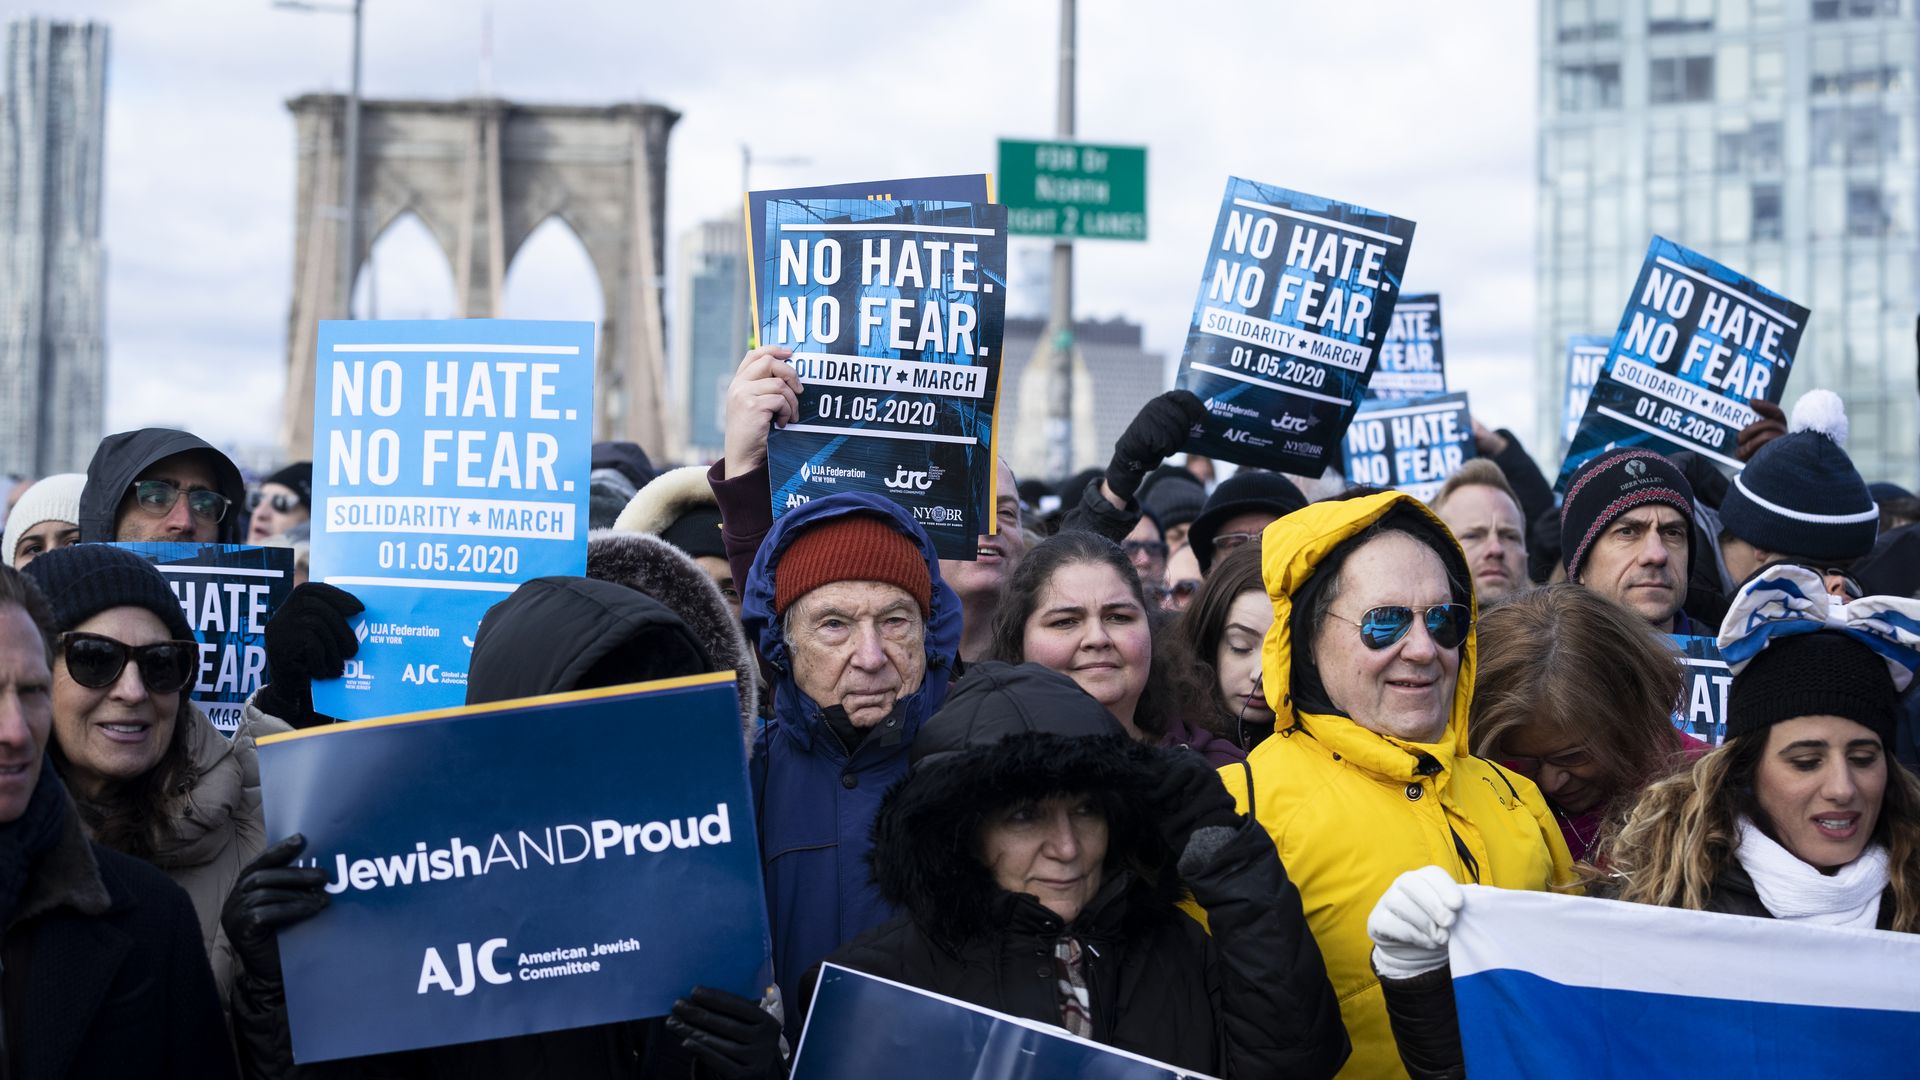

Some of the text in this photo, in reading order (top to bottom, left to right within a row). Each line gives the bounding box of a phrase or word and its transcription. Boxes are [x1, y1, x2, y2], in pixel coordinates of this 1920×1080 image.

[1008, 205, 1144, 236] IGHT 2 LANES
[779, 239, 993, 293] NO HATE.
[1222, 210, 1390, 292] NO HATE.
[1209, 258, 1376, 341] NO FEAR.
[777, 296, 988, 357] NO FEAR.
[1386, 312, 1440, 341] ATE.
[1641, 268, 1787, 368] NO HATE.
[1206, 313, 1363, 367] SOLIDARITY MARCH
[1624, 312, 1679, 364] NO
[784, 358, 976, 392] OLIDARITY MARCH
[1230, 346, 1326, 388] 01.05.2020
[1618, 362, 1699, 405] SOLIDARITY
[331, 361, 577, 420] NO HATE.
[1569, 387, 1588, 419] N
[818, 394, 936, 426] 01.05.2020
[1214, 401, 1259, 418] UJA Federation
[1635, 397, 1725, 449] 01.05.2020
[1223, 428, 1250, 442] AJC
[1348, 412, 1469, 453] NO HATE.
[329, 429, 575, 491] NO FEAR.
[811, 465, 866, 479] UJA Federation
[1352, 454, 1390, 485] NO
[812, 476, 822, 484] NEW
[1620, 476, 1662, 490] DEER VALLEY
[334, 504, 563, 533] SOLIDARITY MARCH
[379, 541, 518, 574] 01.05.2020
[170, 581, 271, 634] HATE
[371, 623, 440, 637] UJA Federation
[371, 636, 402, 645] NEW YORK
[195, 643, 266, 693] EAR
[342, 660, 374, 679] DL.
[402, 664, 439, 685] AJC
[1688, 674, 1734, 724] AT
[208, 708, 241, 726] MAR
[299, 803, 731, 894] JewishANDProud
[417, 938, 512, 996] AJC
[518, 938, 640, 966] American Jewish
[519, 961, 601, 981] Committee
